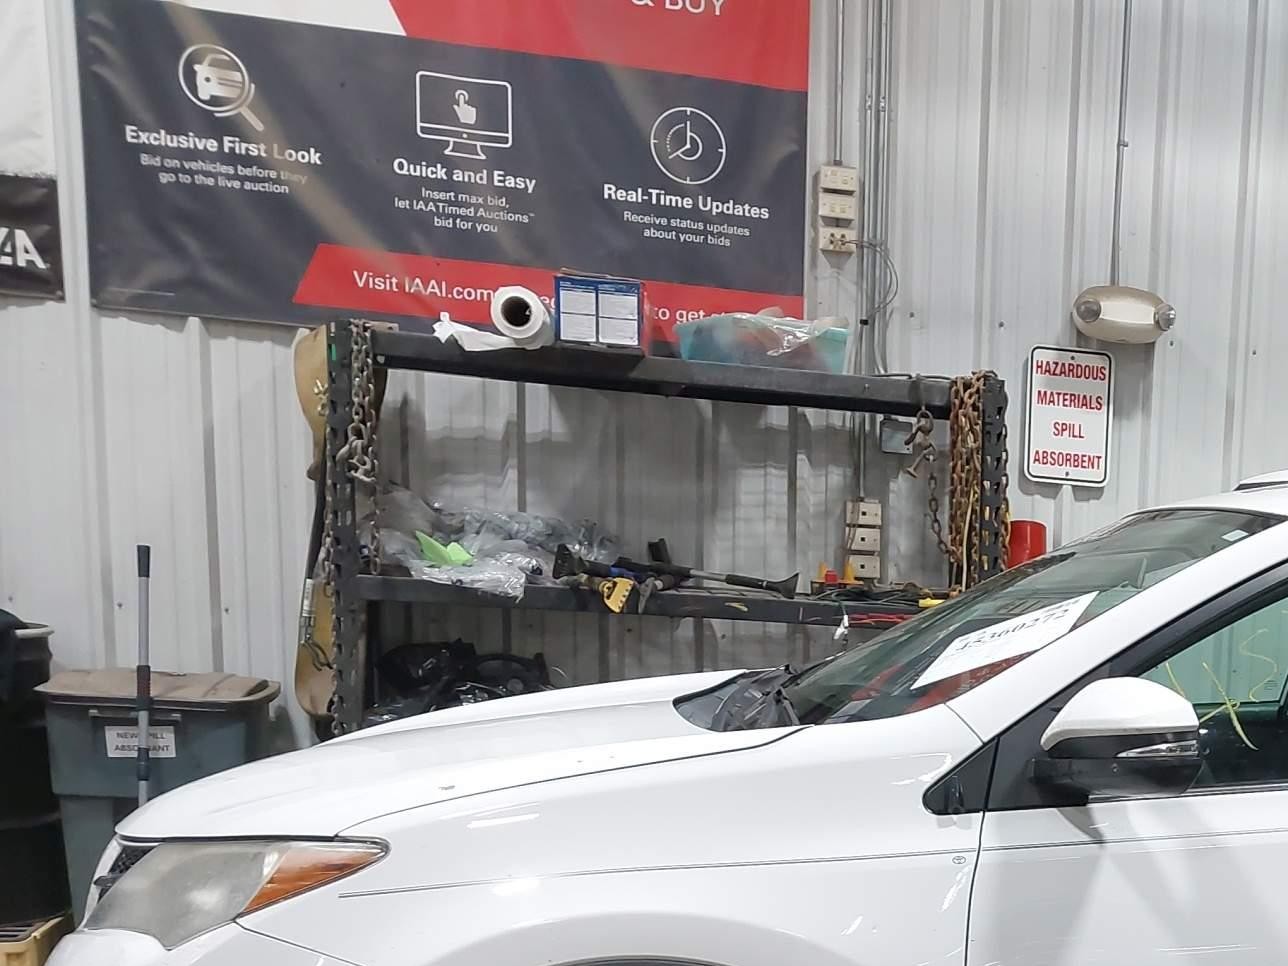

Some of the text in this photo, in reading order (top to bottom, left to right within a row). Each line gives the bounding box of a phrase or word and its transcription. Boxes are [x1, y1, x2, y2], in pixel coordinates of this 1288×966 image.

[125, 125, 322, 165] Exclusive First Look
[140, 153, 308, 184] Bid on vehicles before they
[393, 158, 536, 193] Quick and Easy
[159, 172, 289, 194] go to the live auction
[395, 197, 410, 209] let
[413, 199, 437, 212] IAA
[438, 202, 474, 217] Timed
[422, 187, 509, 208] Insert max bid,
[604, 184, 769, 219] Real-Time Updates
[434, 216, 498, 233] bid for you
[624, 211, 750, 236] Receive status updates
[644, 228, 731, 247] about your bids
[353, 270, 494, 302] Visit IAAI.com
[1036, 360, 1106, 381] HAZARDOUS
[1037, 390, 1103, 411] MATERIALS
[1053, 421, 1085, 439] SPILL
[1033, 450, 1102, 470] ABSORBENT
